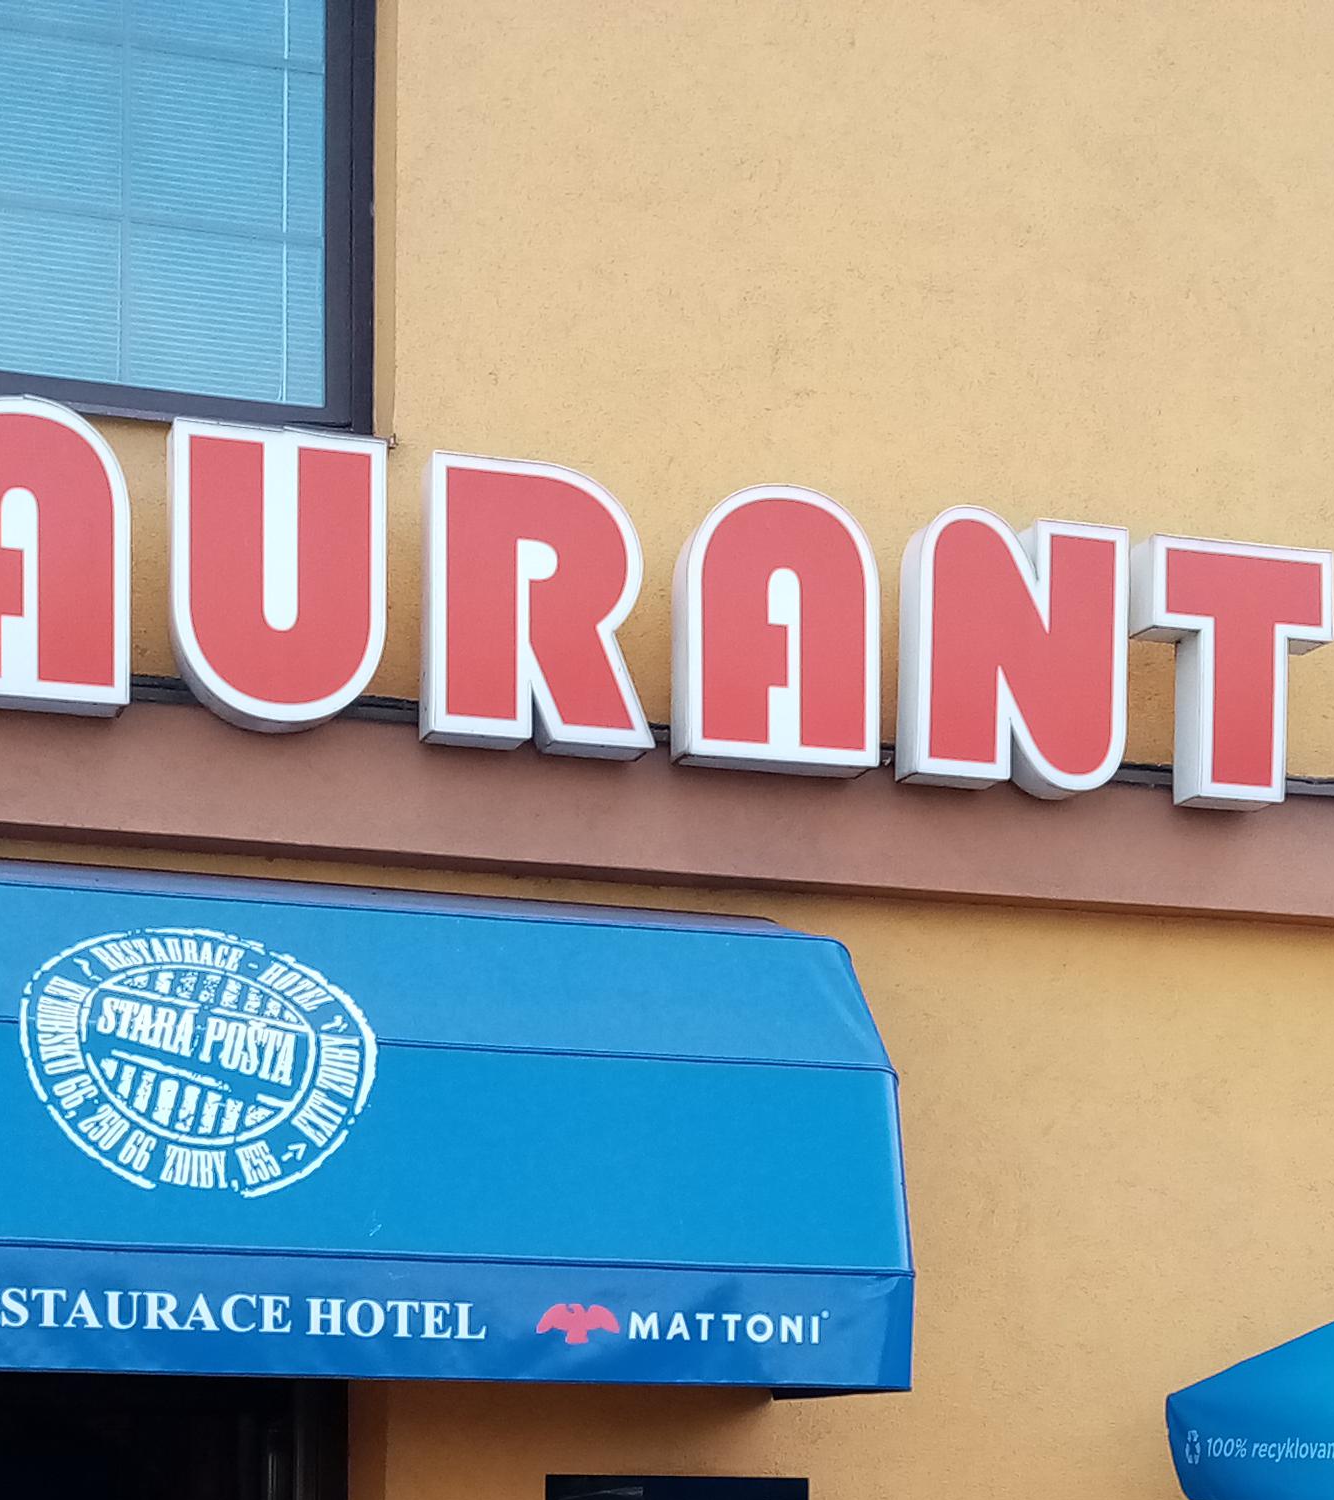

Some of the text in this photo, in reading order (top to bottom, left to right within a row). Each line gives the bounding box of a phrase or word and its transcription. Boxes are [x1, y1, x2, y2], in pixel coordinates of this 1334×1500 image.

[89, 937, 246, 973] RESTAURACE
[257, 960, 336, 1013] HOTEL
[96, 996, 298, 1087] STARÁ POŠTA
[317, 1033, 361, 1099] ZDIBY
[290, 1088, 349, 1149] EXIT
[117, 1129, 158, 1172] 66
[305, 1295, 487, 1340] HOTEL
[628, 1310, 821, 1345] MATTONI
[1206, 1436, 1248, 1459] 100%
